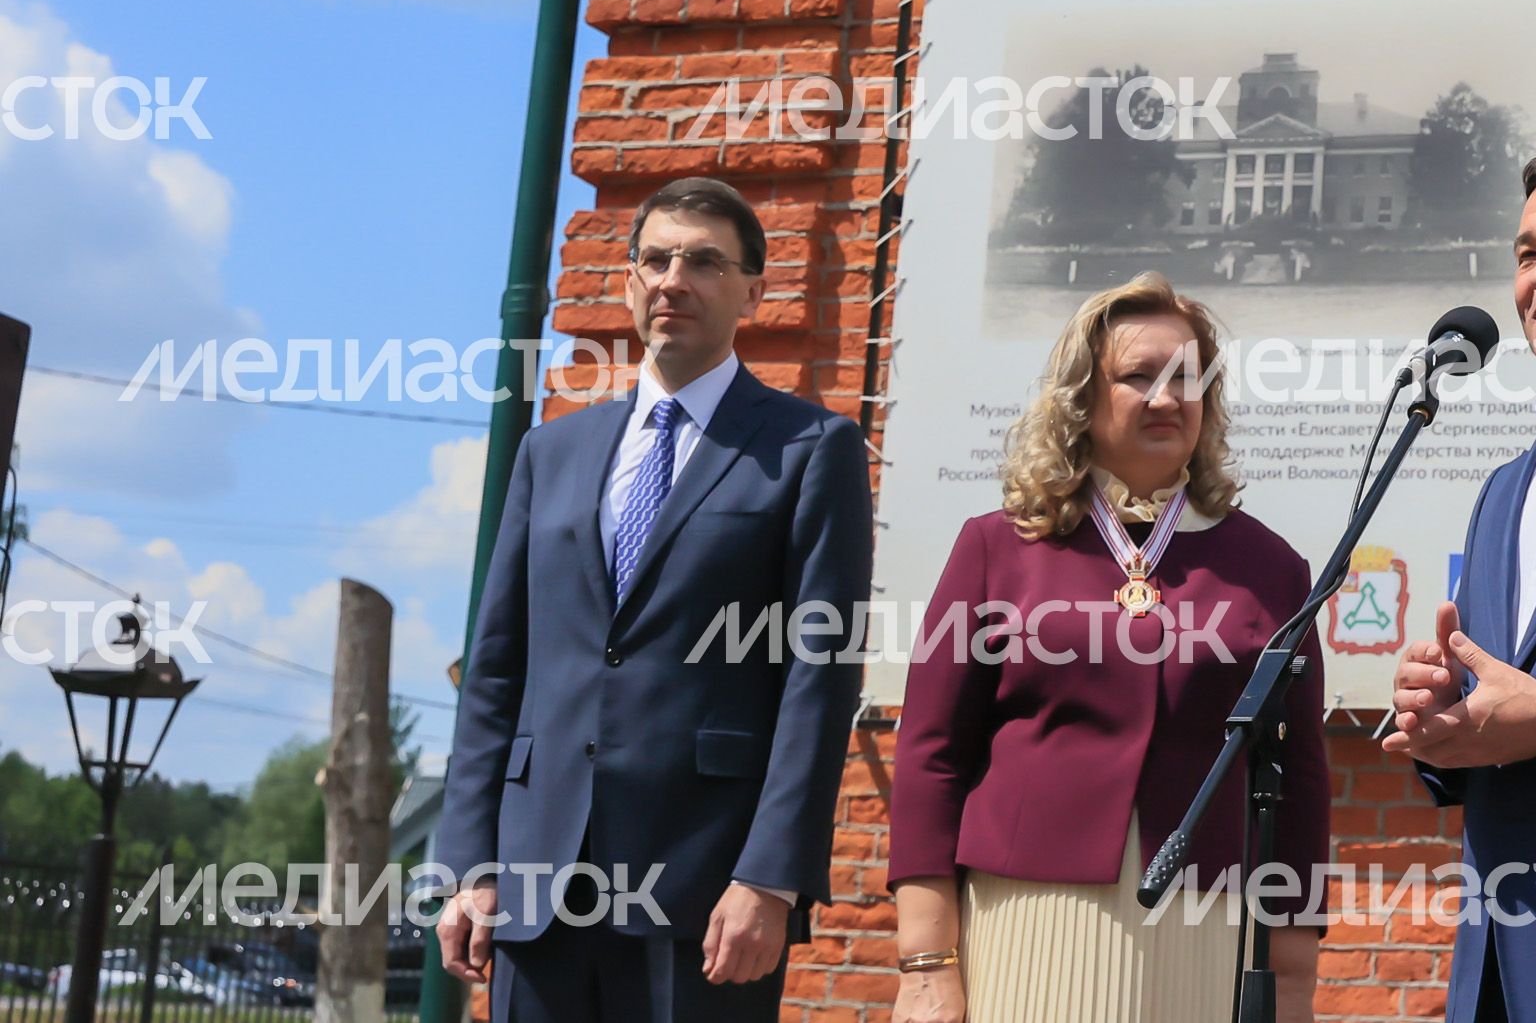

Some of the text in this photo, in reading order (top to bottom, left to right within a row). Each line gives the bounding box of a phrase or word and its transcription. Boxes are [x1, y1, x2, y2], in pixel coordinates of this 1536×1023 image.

[970, 404, 1021, 419] Музей
[1255, 403, 1350, 417] содействия
[1250, 446, 1345, 460] поддержке
